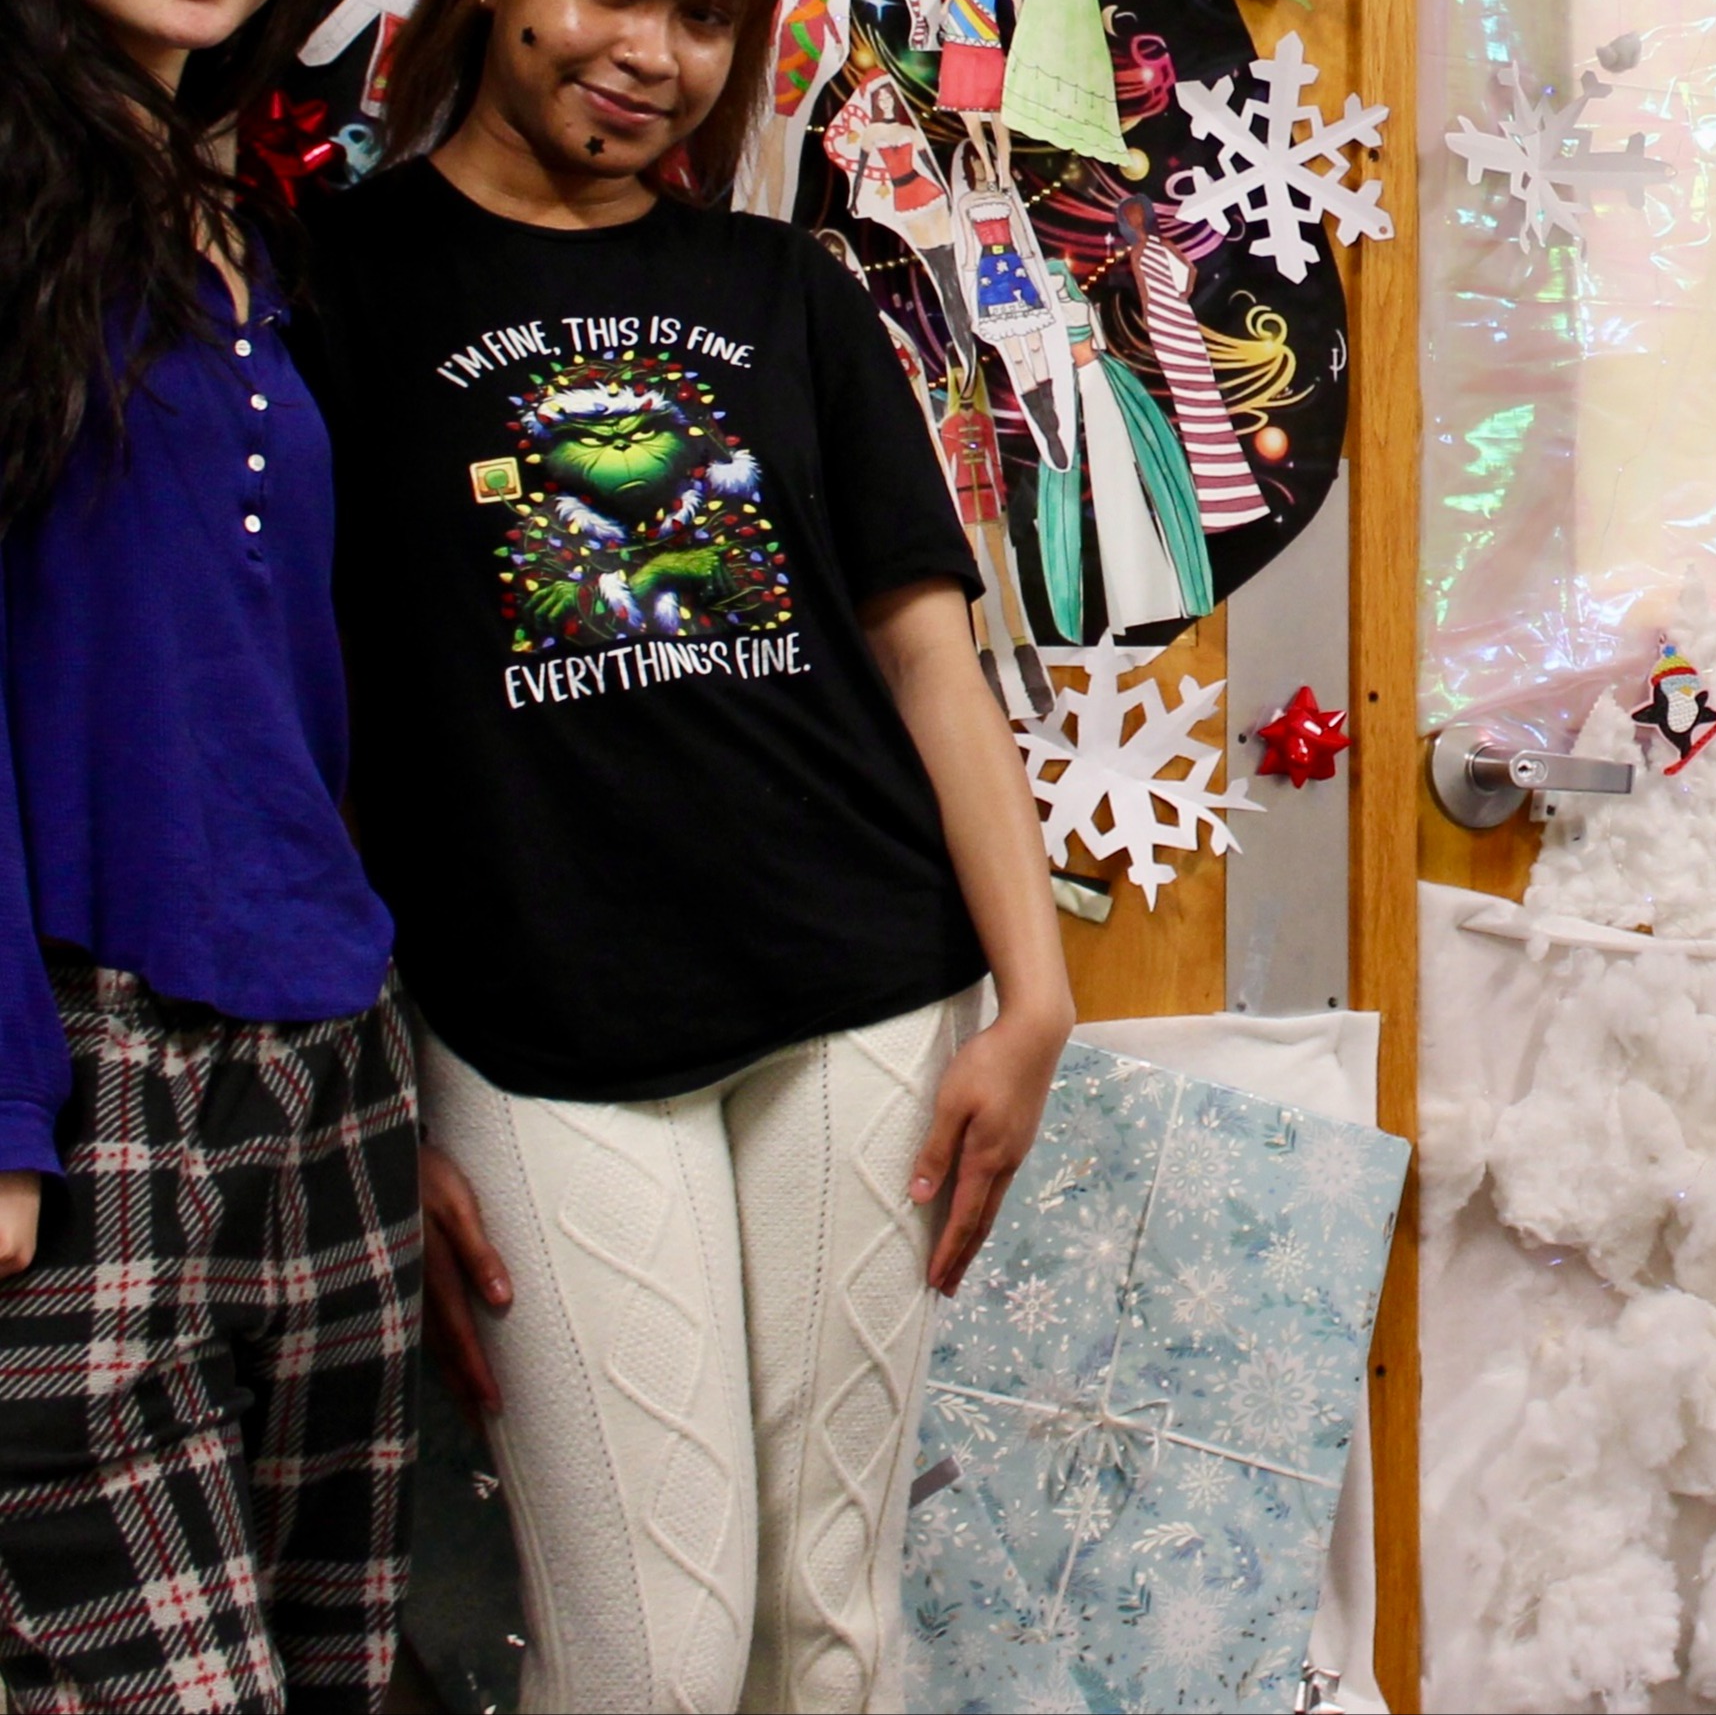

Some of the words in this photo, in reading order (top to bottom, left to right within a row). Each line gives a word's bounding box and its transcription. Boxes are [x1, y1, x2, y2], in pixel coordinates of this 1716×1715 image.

[437, 345, 494, 388] I'M
[481, 320, 562, 367] FINE,
[562, 316, 641, 352] THIS
[650, 315, 682, 345] IS
[686, 325, 755, 369] FINE.
[504, 641, 732, 710] EVERYTHING'S
[735, 632, 812, 680] FINE.
